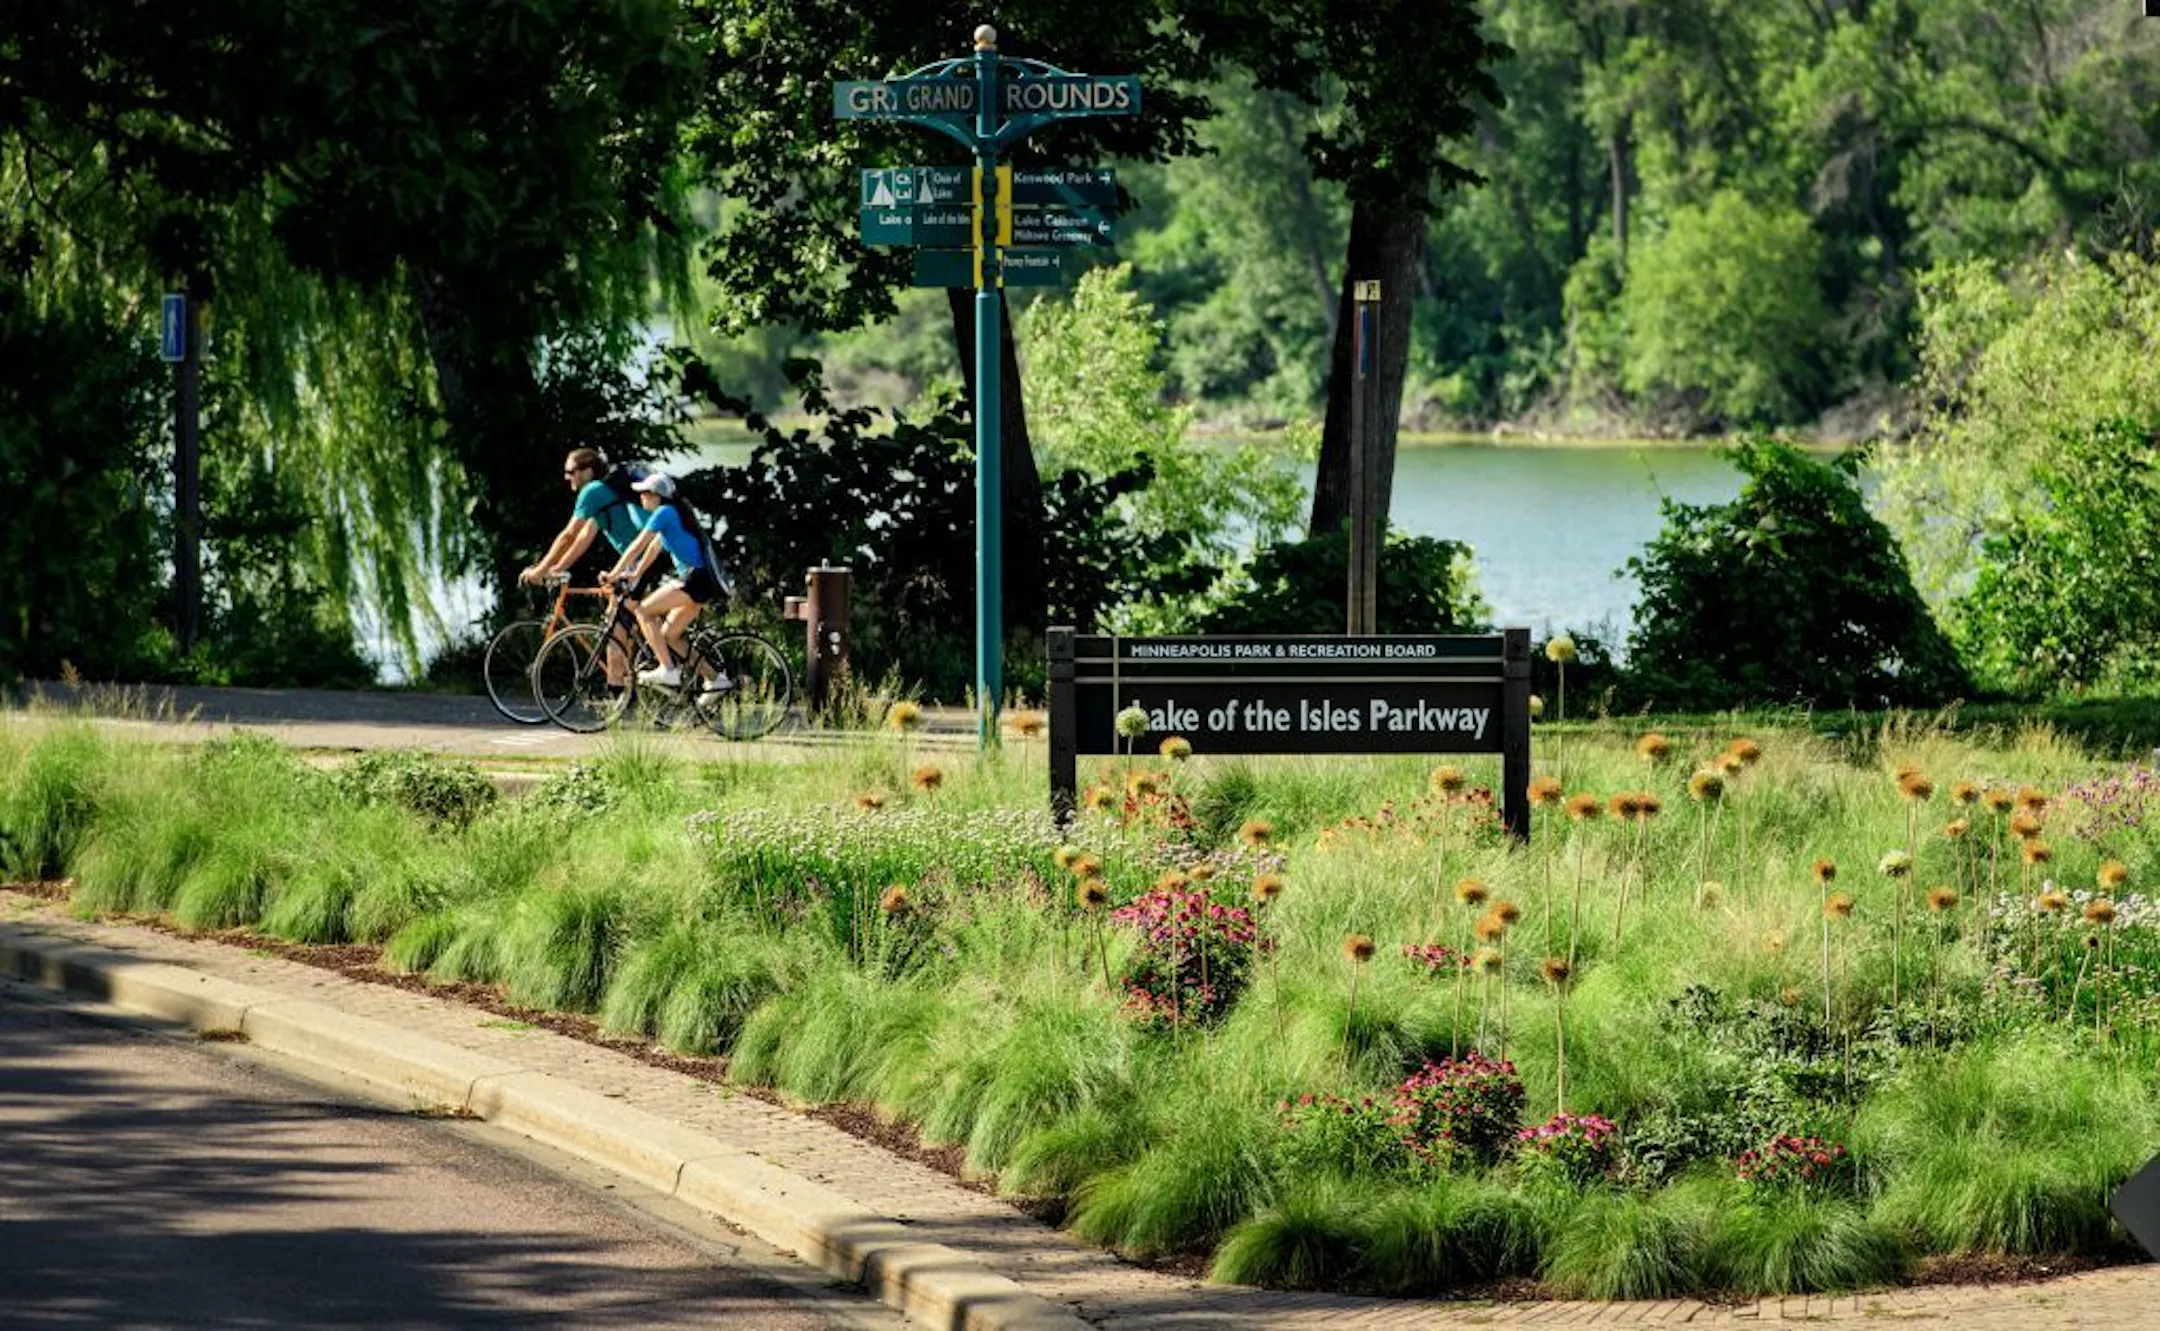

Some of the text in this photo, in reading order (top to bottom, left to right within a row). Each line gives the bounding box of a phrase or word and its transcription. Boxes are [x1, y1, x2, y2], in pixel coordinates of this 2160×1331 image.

[906, 82, 1130, 110] GRAND ROUNDS
[1014, 171, 1092, 184] Kenwood Park
[1014, 214, 1041, 227] Lake
[1130, 644, 1437, 658] MINNEAPOLIS PARK & RECREATION BOARD
[1208, 699, 1240, 731] of
[1244, 700, 1290, 731] the
[1300, 699, 1361, 731] Isles
[1370, 699, 1490, 739] Parkway
